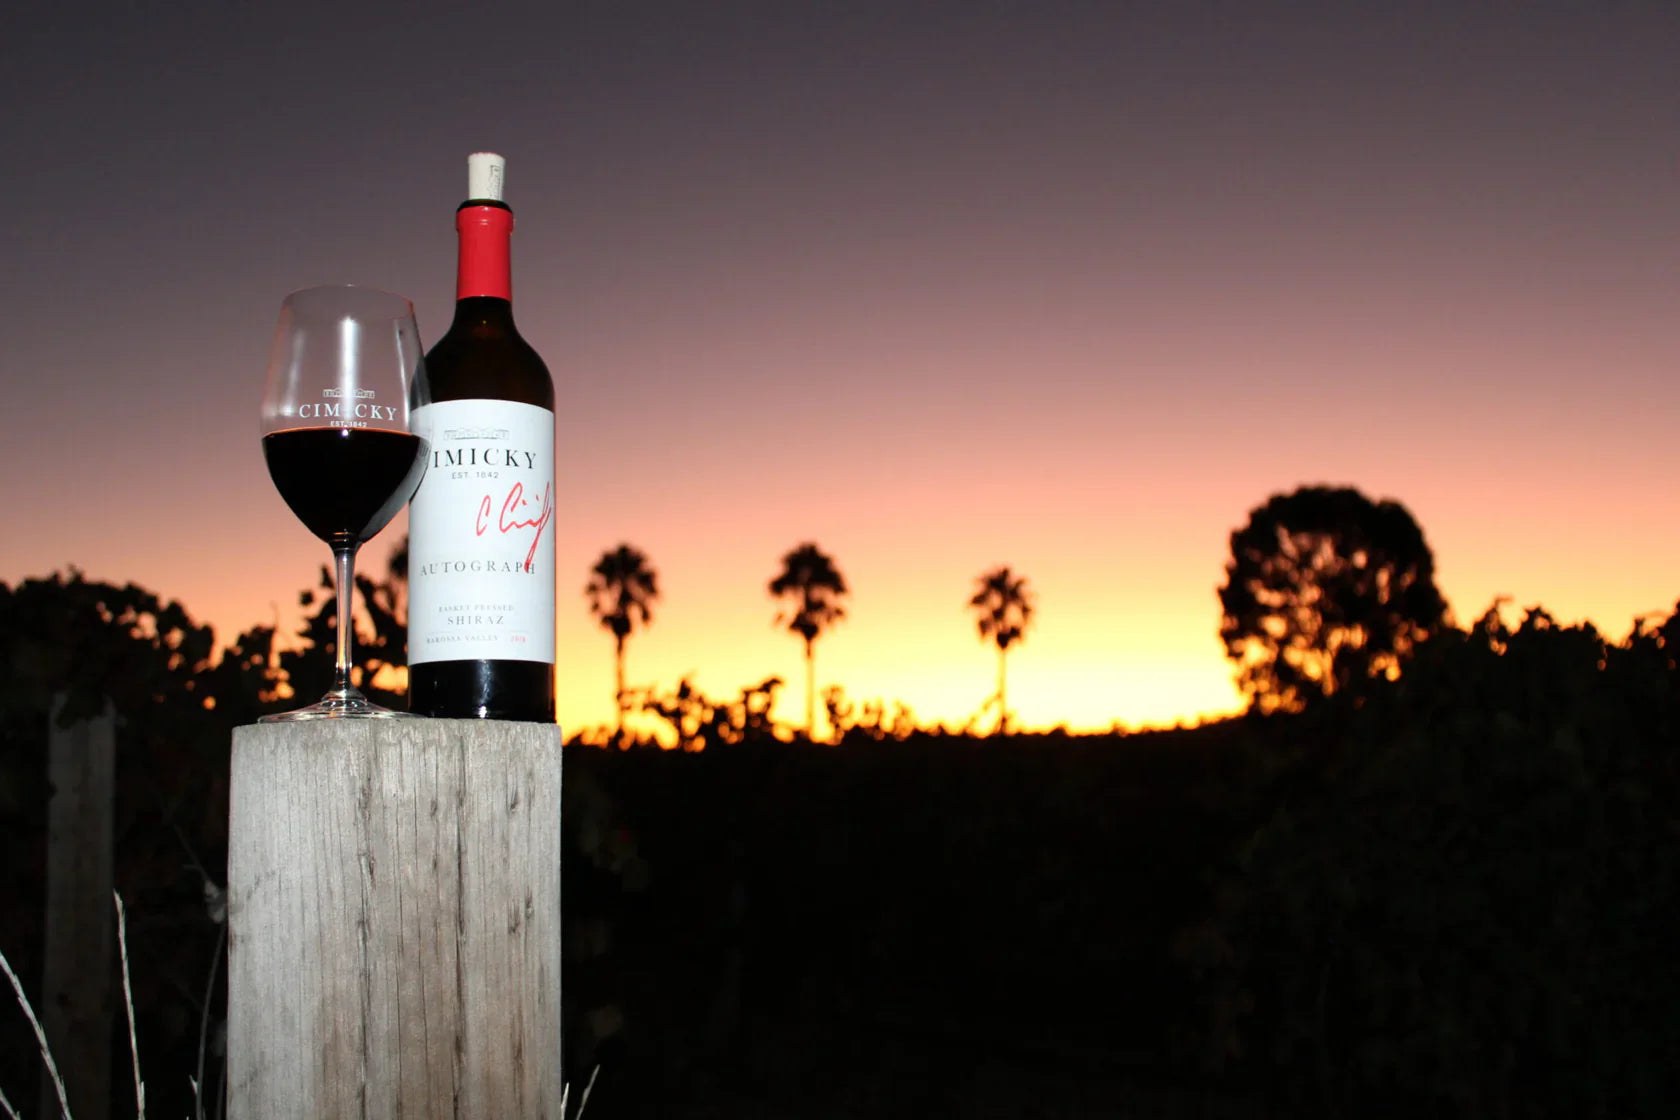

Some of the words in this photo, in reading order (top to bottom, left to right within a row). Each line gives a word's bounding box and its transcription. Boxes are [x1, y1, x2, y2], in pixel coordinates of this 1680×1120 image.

[299, 403, 397, 421] CIMCKY
[433, 448, 537, 469] IMICKY
[476, 471, 499, 479] 1842
[420, 559, 536, 576] AUTOGRAPH
[438, 605, 471, 613] BASKET
[474, 604, 515, 612] PRESSED
[447, 615, 504, 626] SHIRAZ
[426, 635, 462, 645] BAROSSA
[465, 634, 499, 642] VALLEY
